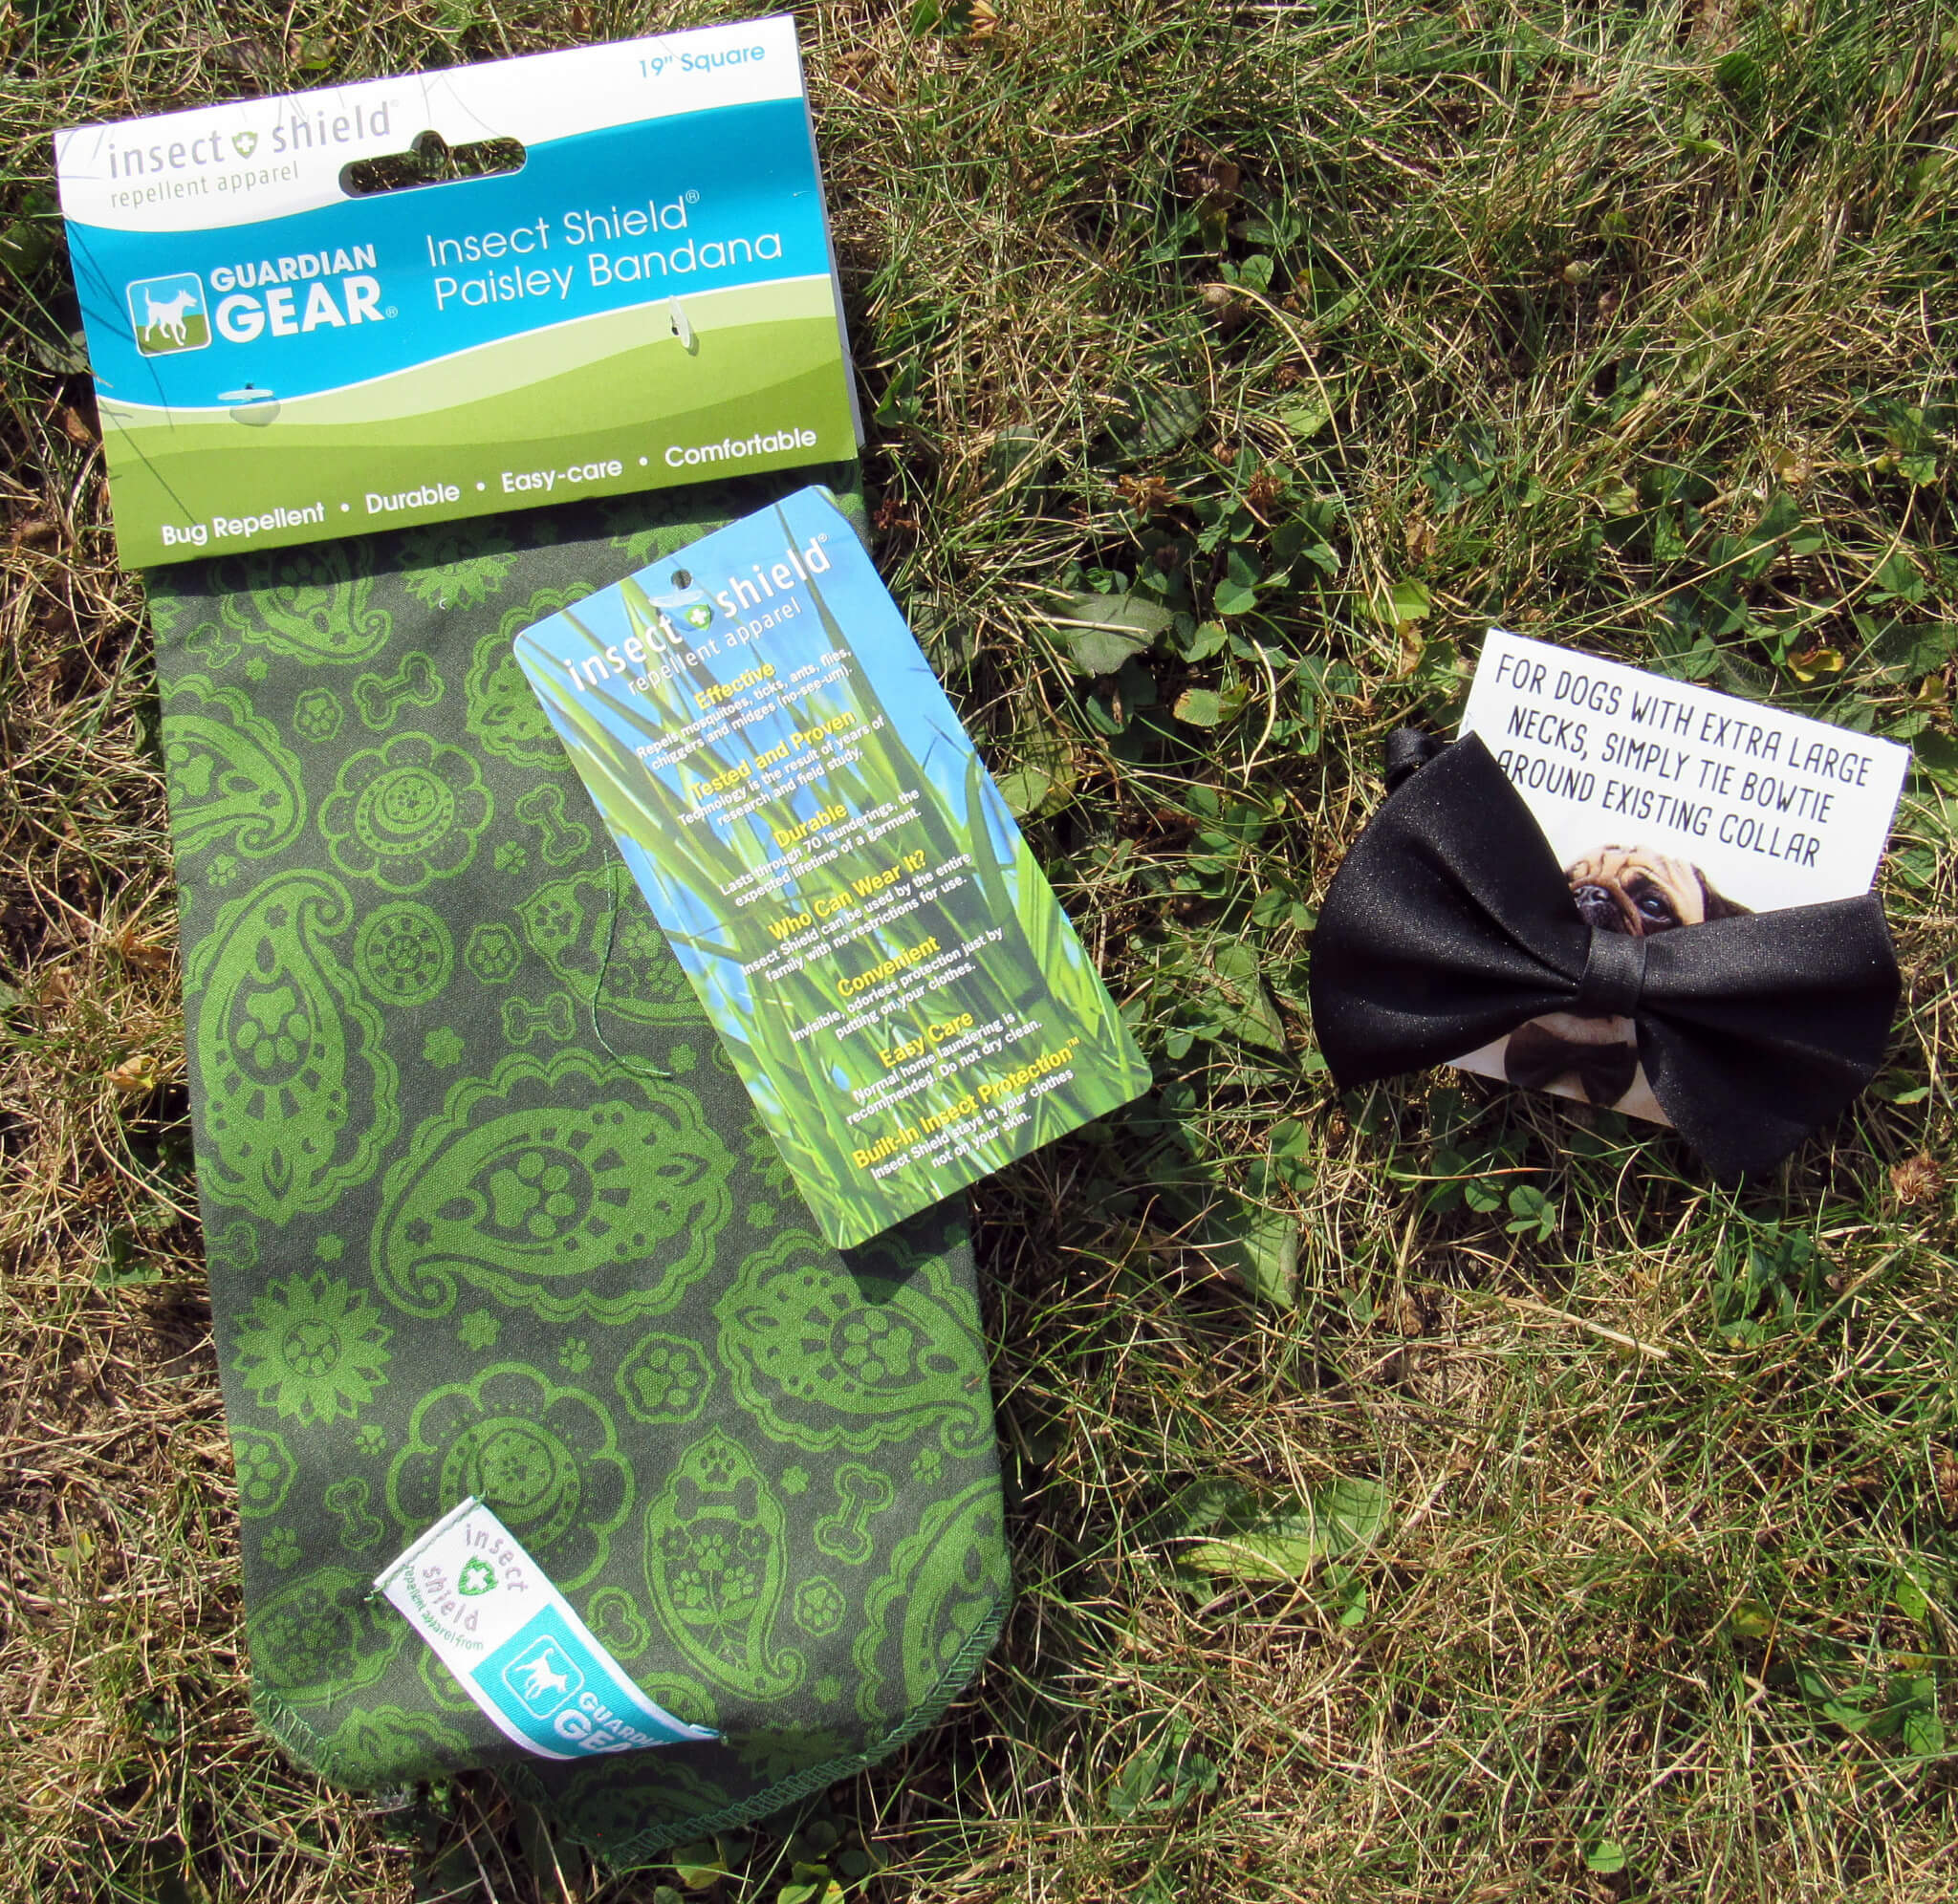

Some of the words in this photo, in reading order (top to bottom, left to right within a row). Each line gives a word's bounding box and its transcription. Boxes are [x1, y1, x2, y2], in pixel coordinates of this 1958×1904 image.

[681, 45, 766, 74] Square
[108, 130, 226, 179] insect
[111, 180, 209, 209] repellent
[217, 161, 299, 192] apparel
[210, 245, 378, 289] GUARDIAN
[426, 217, 551, 268] Insect
[434, 265, 574, 311] Paisley
[588, 232, 782, 288] Bandana
[161, 522, 208, 547] Bug
[213, 502, 325, 539] Repellent
[366, 483, 462, 515] Durable
[501, 458, 623, 494] Easy-care
[664, 426, 818, 469] Comfortable
[564, 614, 683, 691] insect
[627, 639, 721, 696] repellent
[726, 596, 802, 648] apparel
[636, 731, 681, 759] Repels
[681, 697, 753, 739] mosquitoes,
[753, 676, 789, 700] ticks,
[790, 663, 819, 683] ants,
[820, 649, 852, 667] flies,
[651, 737, 705, 770] chiggers
[707, 724, 729, 744] and
[731, 702, 777, 732] midges
[779, 668, 853, 708] (no-see-um).
[694, 663, 775, 710] Effective
[1495, 653, 1547, 695] FOR
[1555, 670, 1621, 715] DOGS
[1630, 690, 1694, 737] WITH
[1700, 712, 1782, 762] EXTRA
[1788, 736, 1874, 788] LARGE
[678, 785, 748, 828] Technology
[748, 779, 760, 792] is
[762, 768, 782, 785] the
[784, 750, 819, 774] result
[821, 742, 835, 755] of
[836, 725, 871, 750] years
[872, 715, 885, 730] of
[689, 760, 751, 801] Tested
[754, 742, 790, 770] and
[790, 711, 857, 751] Proven
[1508, 704, 1588, 762] NECKS,
[1601, 732, 1689, 782] SIMPLY
[1699, 759, 1735, 795] TIE
[1740, 772, 1835, 824] BOWTIE
[717, 790, 772, 827] research
[773, 779, 796, 798] and
[797, 766, 825, 787] field
[772, 803, 847, 849] Durable
[1497, 748, 1596, 802] AROUND
[1601, 779, 1712, 837] EXISTING
[1719, 813, 1820, 869] COLLAR
[719, 872, 754, 897] Lasts
[755, 848, 802, 879] through
[803, 838, 822, 854] 70
[822, 802, 899, 843] launderings,
[898, 789, 921, 806] the
[735, 874, 792, 907] expected
[792, 851, 838, 877] lifetime
[840, 840, 855, 854] of
[856, 836, 864, 846] a
[866, 809, 922, 843] garment.
[742, 949, 781, 977] Insect
[780, 929, 819, 957] Shield
[820, 919, 843, 935] can
[845, 908, 862, 923] be
[863, 894, 896, 914] used
[895, 882, 911, 898] by
[911, 872, 934, 888] the
[935, 854, 972, 876] entire
[765, 958, 805, 983] family
[806, 943, 832, 963] with
[834, 934, 849, 948] no
[850, 899, 920, 940] restrictions
[920, 889, 938, 905] for
[939, 876, 968, 895] use.
[768, 913, 812, 941] Who
[814, 893, 853, 919] Can
[851, 867, 902, 898] Wear
[903, 850, 925, 873] It?
[790, 1011, 846, 1043] Invisible,
[845, 981, 899, 1012] odorless
[900, 949, 961, 988] protection
[961, 936, 987, 958] just
[988, 926, 1004, 941] by
[834, 1011, 880, 1041] putting
[881, 1002, 896, 1016] on
[898, 984, 926, 1009] your
[927, 962, 976, 991] clothes.
[838, 936, 941, 997] Convenient
[846, 1071, 940, 1125] recommended.
[939, 1061, 957, 1078] Do
[960, 1049, 981, 1068] not
[982, 1036, 1004, 1057] dry
[1004, 1020, 1042, 1044] clean.
[852, 1071, 901, 1102] Normal
[901, 1053, 936, 1078] home
[937, 1021, 1004, 1059] laundering
[1003, 1011, 1015, 1027] is
[879, 1036, 926, 1069] Easy
[927, 1012, 974, 1044] Care
[852, 1124, 921, 1169] Built-In
[920, 1093, 979, 1134] Insect
[871, 1154, 911, 1180] Insect
[910, 1133, 950, 1158] Shield
[952, 1116, 985, 1143] stays
[984, 1108, 998, 1121] in
[1000, 1091, 1028, 1115] your
[1029, 1069, 1075, 1098] clothes
[931, 1150, 952, 1168] not
[954, 1141, 970, 1156] on
[972, 1123, 1000, 1149] your
[1001, 1113, 1032, 1132] skin.
[466, 1523, 529, 1592] insect
[423, 1566, 479, 1633] shield
[454, 1634, 484, 1651] from
[554, 1709, 632, 1752] GEA
[578, 1692, 670, 1748] GUARDI
